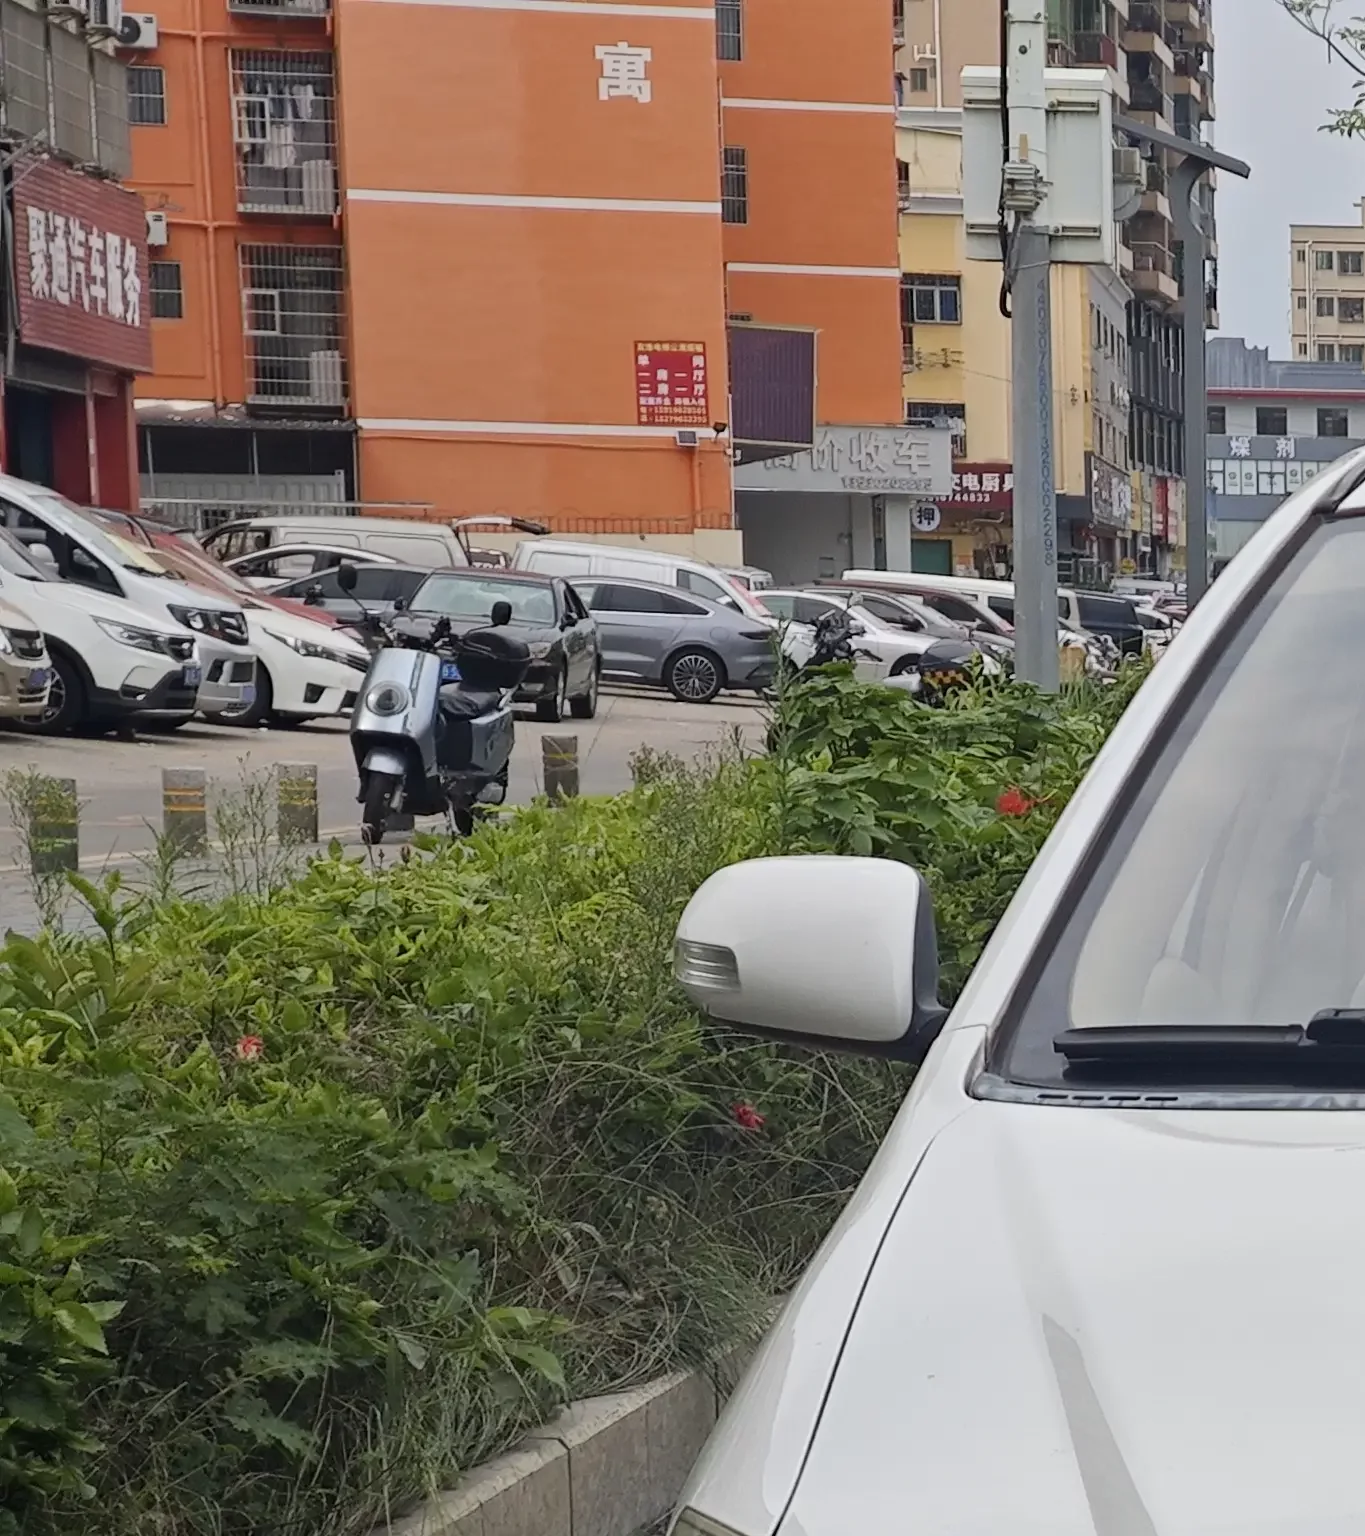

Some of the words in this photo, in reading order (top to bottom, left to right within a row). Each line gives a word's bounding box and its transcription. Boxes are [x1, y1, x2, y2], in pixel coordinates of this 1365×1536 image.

[594, 40, 652, 104] 寓
[26, 205, 142, 327] 聚通汽车服务
[917, 507, 935, 526] 押
